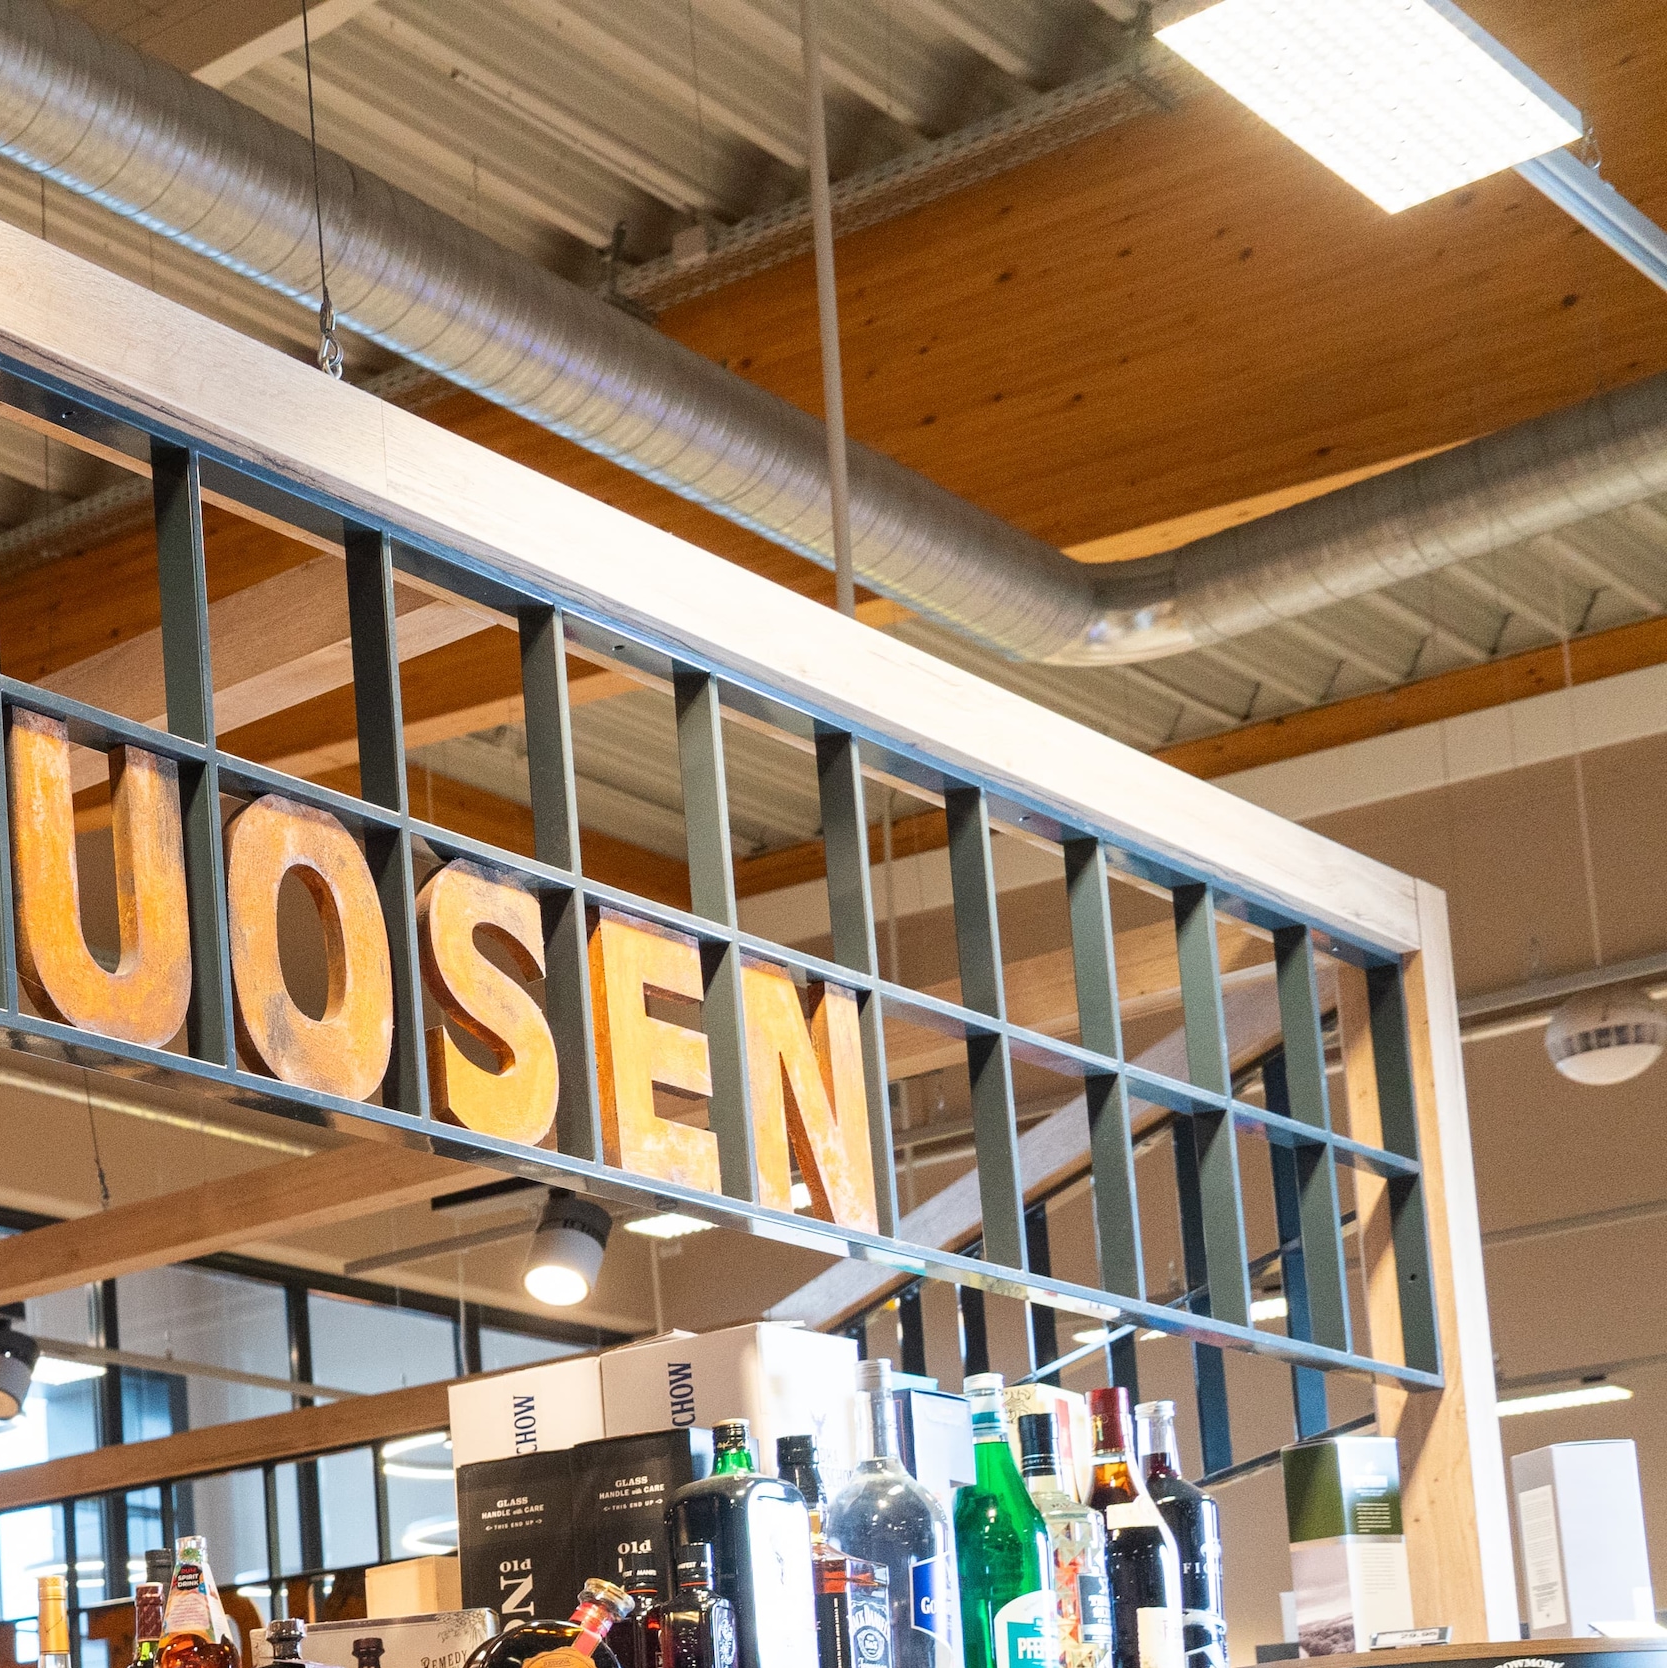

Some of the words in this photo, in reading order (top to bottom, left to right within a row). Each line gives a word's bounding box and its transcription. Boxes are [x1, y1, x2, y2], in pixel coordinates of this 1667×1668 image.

[615, 1475, 648, 1488] GLASS
[599, 1486, 629, 1500] HANDLE
[644, 1483, 665, 1495] CARE
[496, 1496, 528, 1508] GLASS
[612, 1503, 627, 1511] THIS
[628, 1502, 643, 1510] END
[644, 1500, 655, 1508] UP
[481, 1507, 510, 1520] HANDLE
[524, 1503, 545, 1513] CARE
[525, 1520, 535, 1528] UP
[617, 1540, 652, 1554] Old
[499, 1558, 532, 1573] Old
[177, 1572, 199, 1582] SPIRIT
[177, 1580, 199, 1588] DRINK
